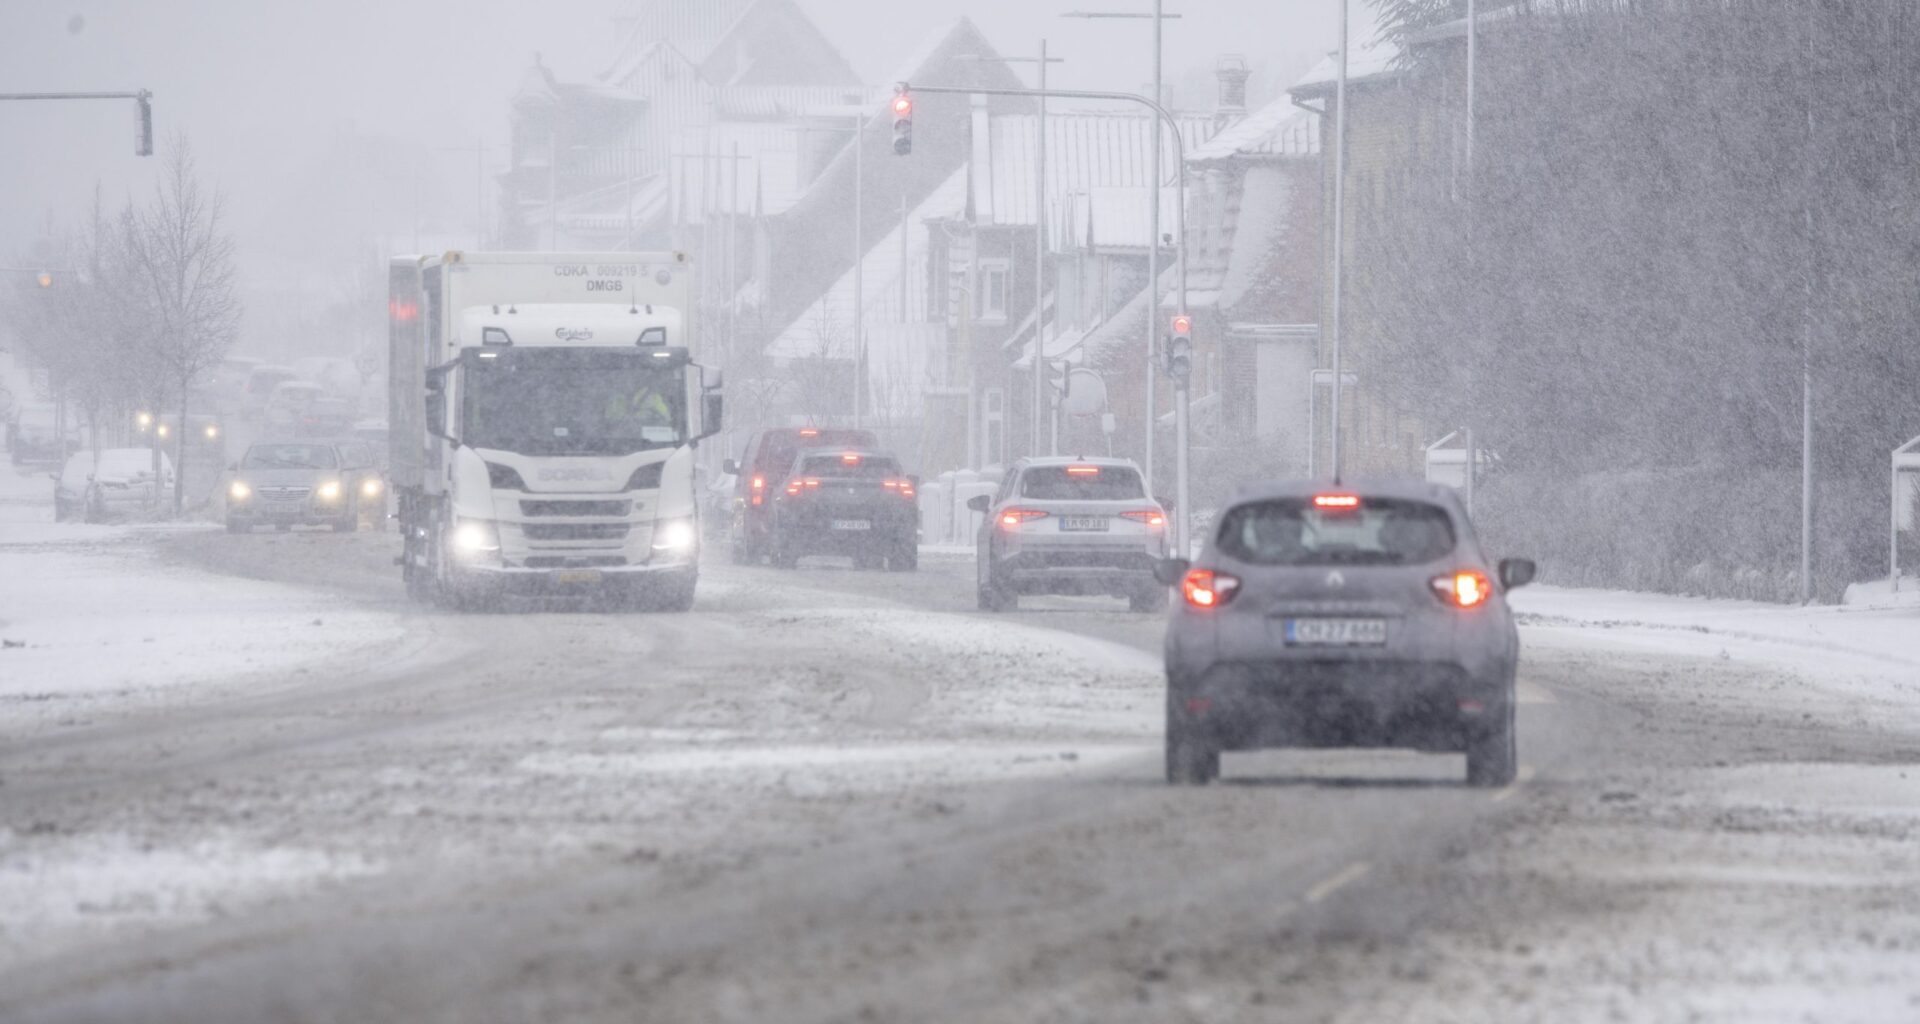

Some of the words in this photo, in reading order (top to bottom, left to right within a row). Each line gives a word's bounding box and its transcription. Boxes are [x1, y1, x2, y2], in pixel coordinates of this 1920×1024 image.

[554, 265, 589, 276] CDKA
[597, 265, 637, 276] 009219
[586, 280, 623, 291] DMGB
[555, 327, 593, 342] Carlsberg
[1326, 619, 1350, 642] 27
